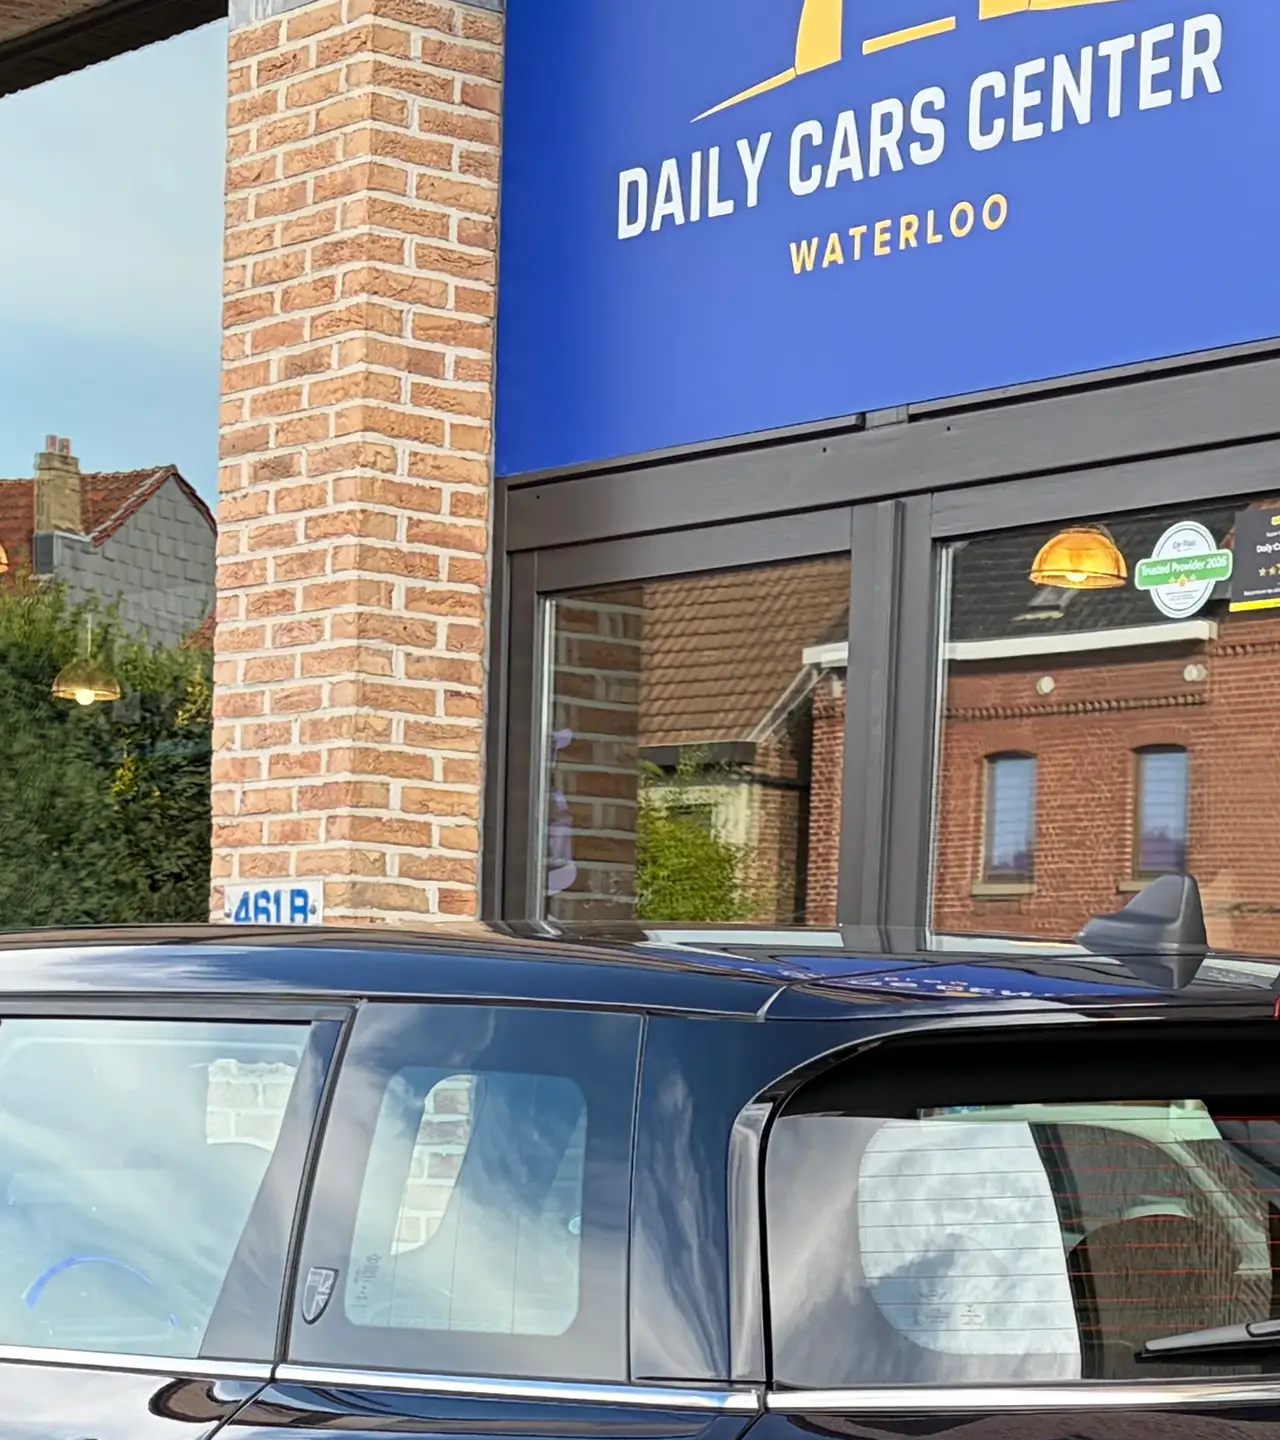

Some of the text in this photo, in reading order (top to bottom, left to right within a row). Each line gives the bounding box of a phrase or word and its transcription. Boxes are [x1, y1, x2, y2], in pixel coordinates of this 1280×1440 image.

[617, 13, 1223, 240] DAILY CARS CENTER
[789, 193, 1009, 275] WATERLOO
